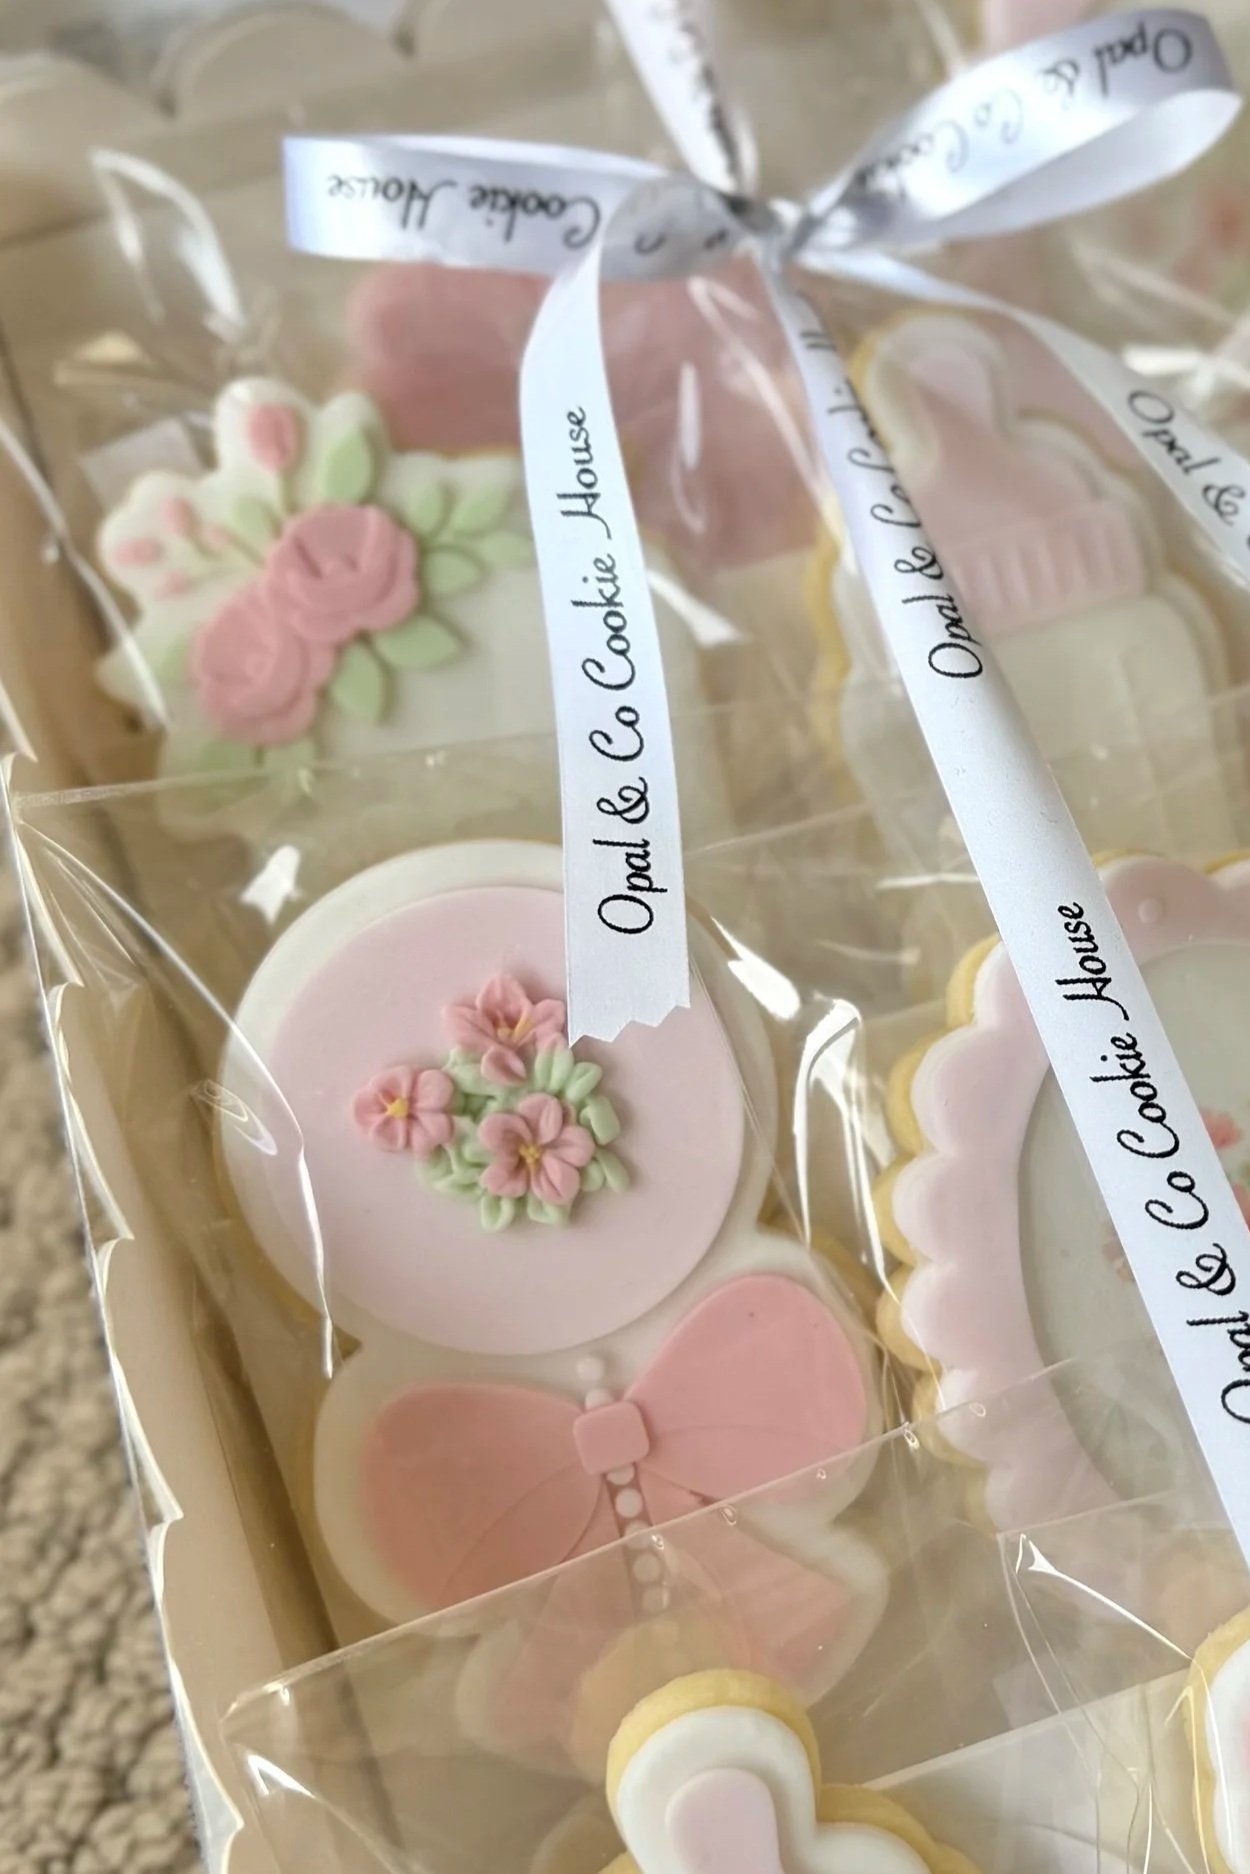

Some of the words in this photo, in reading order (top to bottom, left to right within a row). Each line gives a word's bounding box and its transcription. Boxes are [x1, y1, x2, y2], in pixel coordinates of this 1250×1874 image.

[1093, 24, 1193, 97] Opal
[974, 87, 1023, 145] Co
[327, 174, 458, 229] House
[469, 183, 601, 250] Cookie
[556, 406, 612, 540] House
[1128, 390, 1220, 476] Opal
[1202, 484, 1246, 525] &
[895, 547, 944, 580] &
[570, 553, 636, 691] Cookie
[901, 594, 983, 678] Opal
[588, 705, 644, 762] Co
[596, 776, 650, 824] &
[592, 838, 668, 934] Opal
[1056, 902, 1129, 1020] House
[1090, 1033, 1180, 1159] Cookie
[1145, 1171, 1209, 1230] Co
[1176, 1243, 1236, 1296] &
